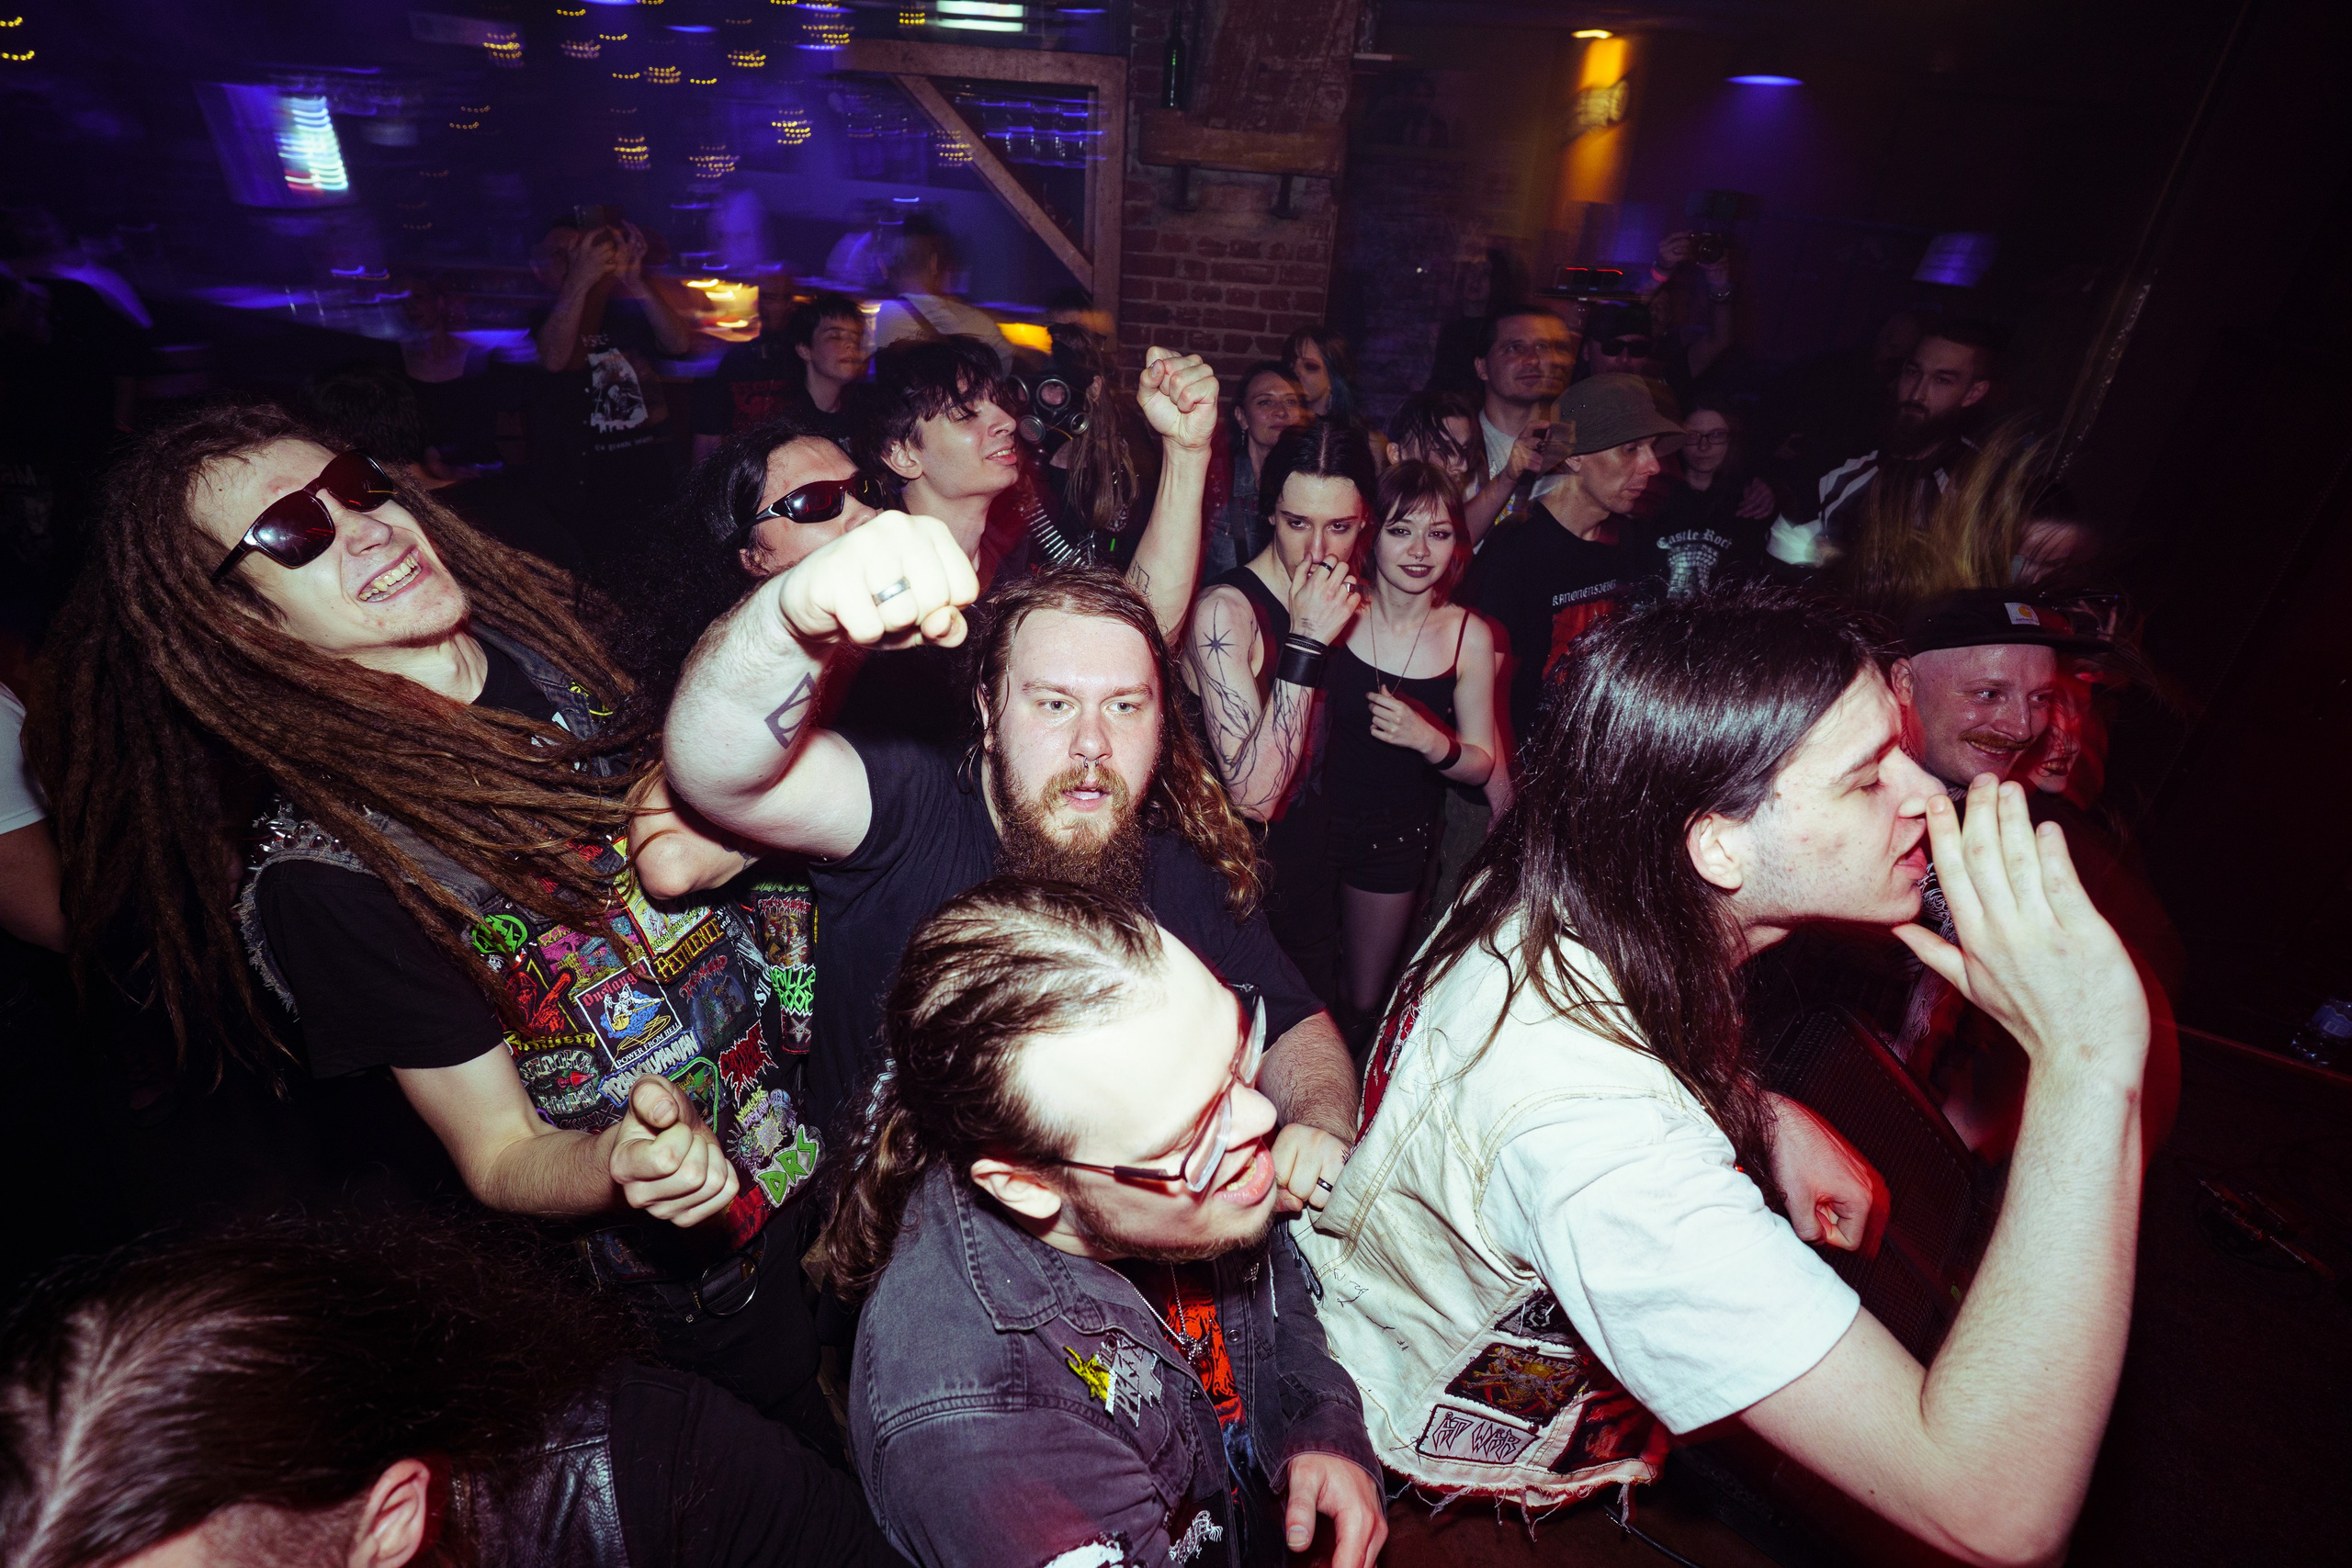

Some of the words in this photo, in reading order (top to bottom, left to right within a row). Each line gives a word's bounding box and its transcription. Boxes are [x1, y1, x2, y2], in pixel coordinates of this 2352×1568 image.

[1657, 529, 1699, 550] Castle
[653, 918, 724, 979] PESTILENCE
[582, 963, 647, 1008] Onslaugt
[616, 1047, 644, 1066] POWER
[643, 1034, 664, 1051] FROM
[664, 1022, 680, 1039] HELL
